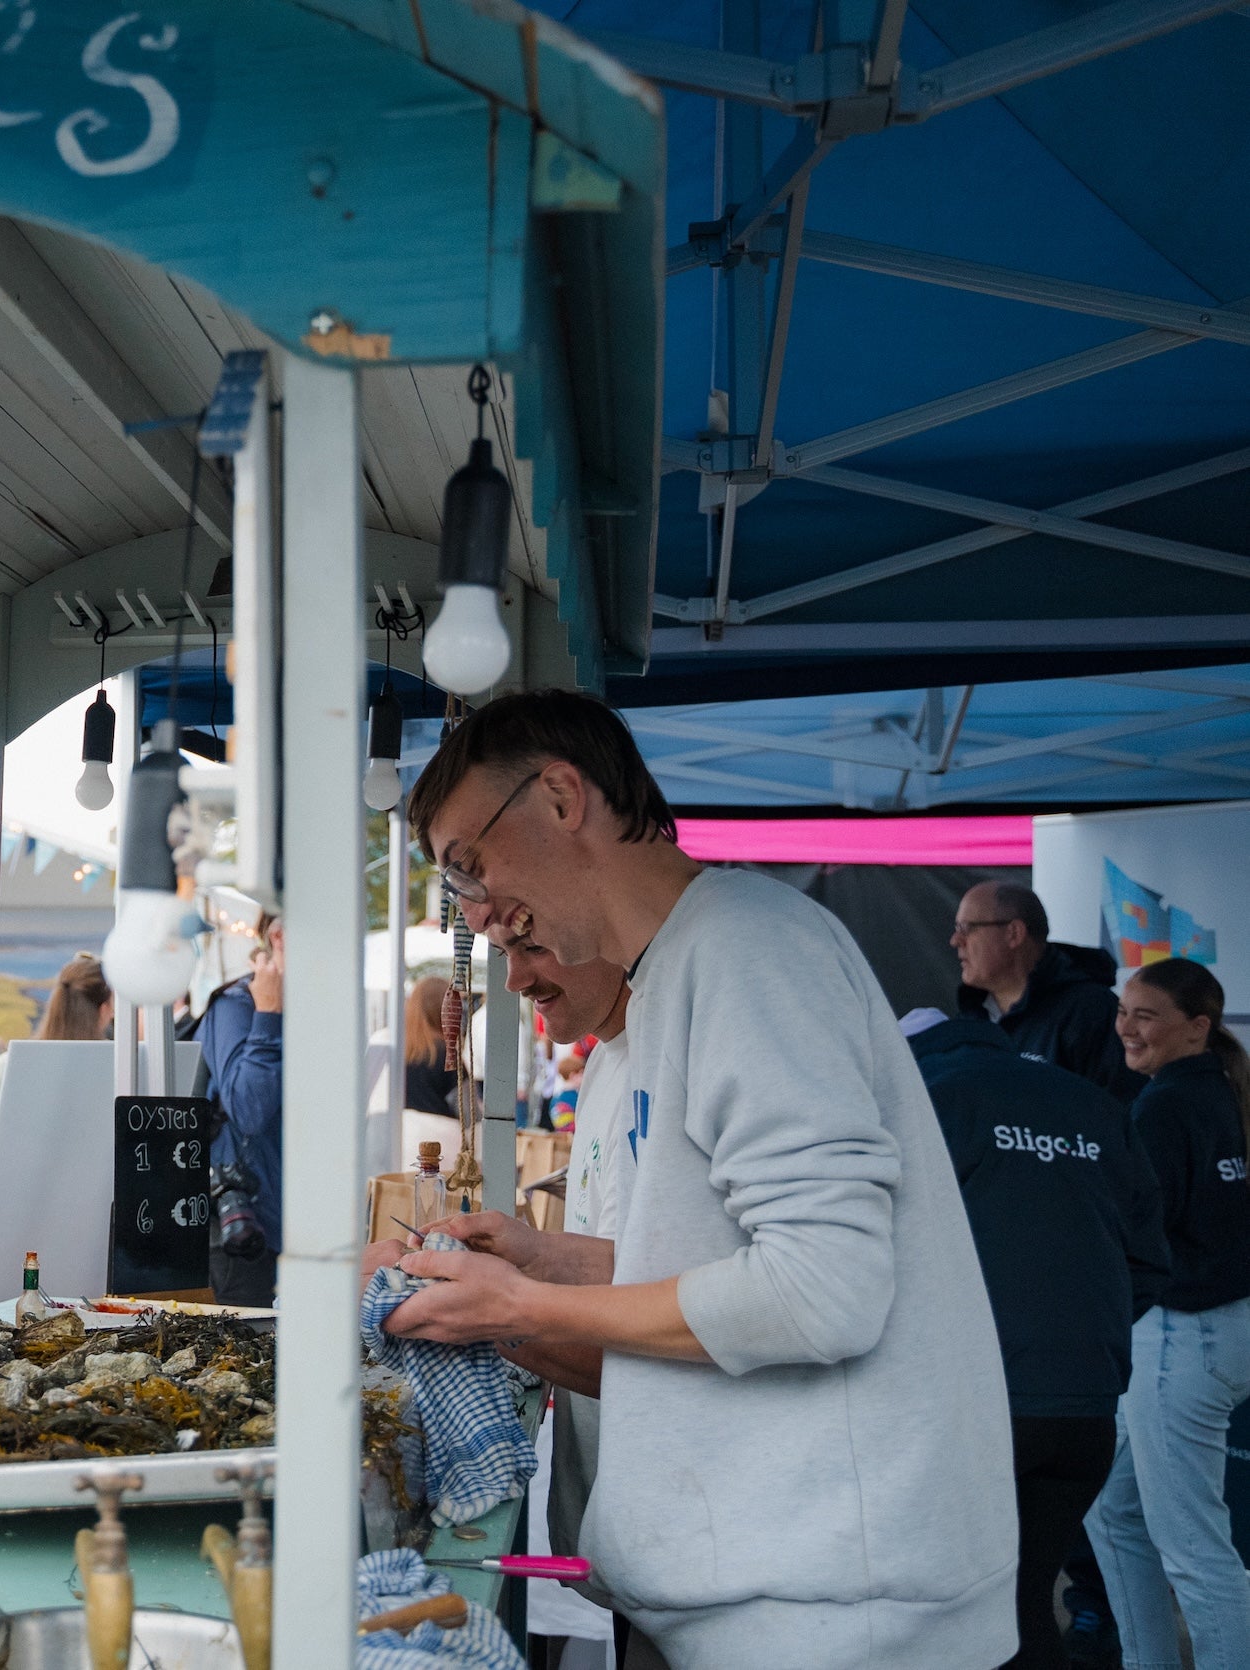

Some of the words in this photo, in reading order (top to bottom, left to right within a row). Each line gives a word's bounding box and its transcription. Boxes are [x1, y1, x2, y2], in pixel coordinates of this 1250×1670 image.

[134, 1142, 151, 1172] 1
[172, 1139, 202, 1169] €2
[993, 1124, 1100, 1163] Sligo.ie
[136, 1198, 154, 1234] 6
[170, 1192, 210, 1227] €10
